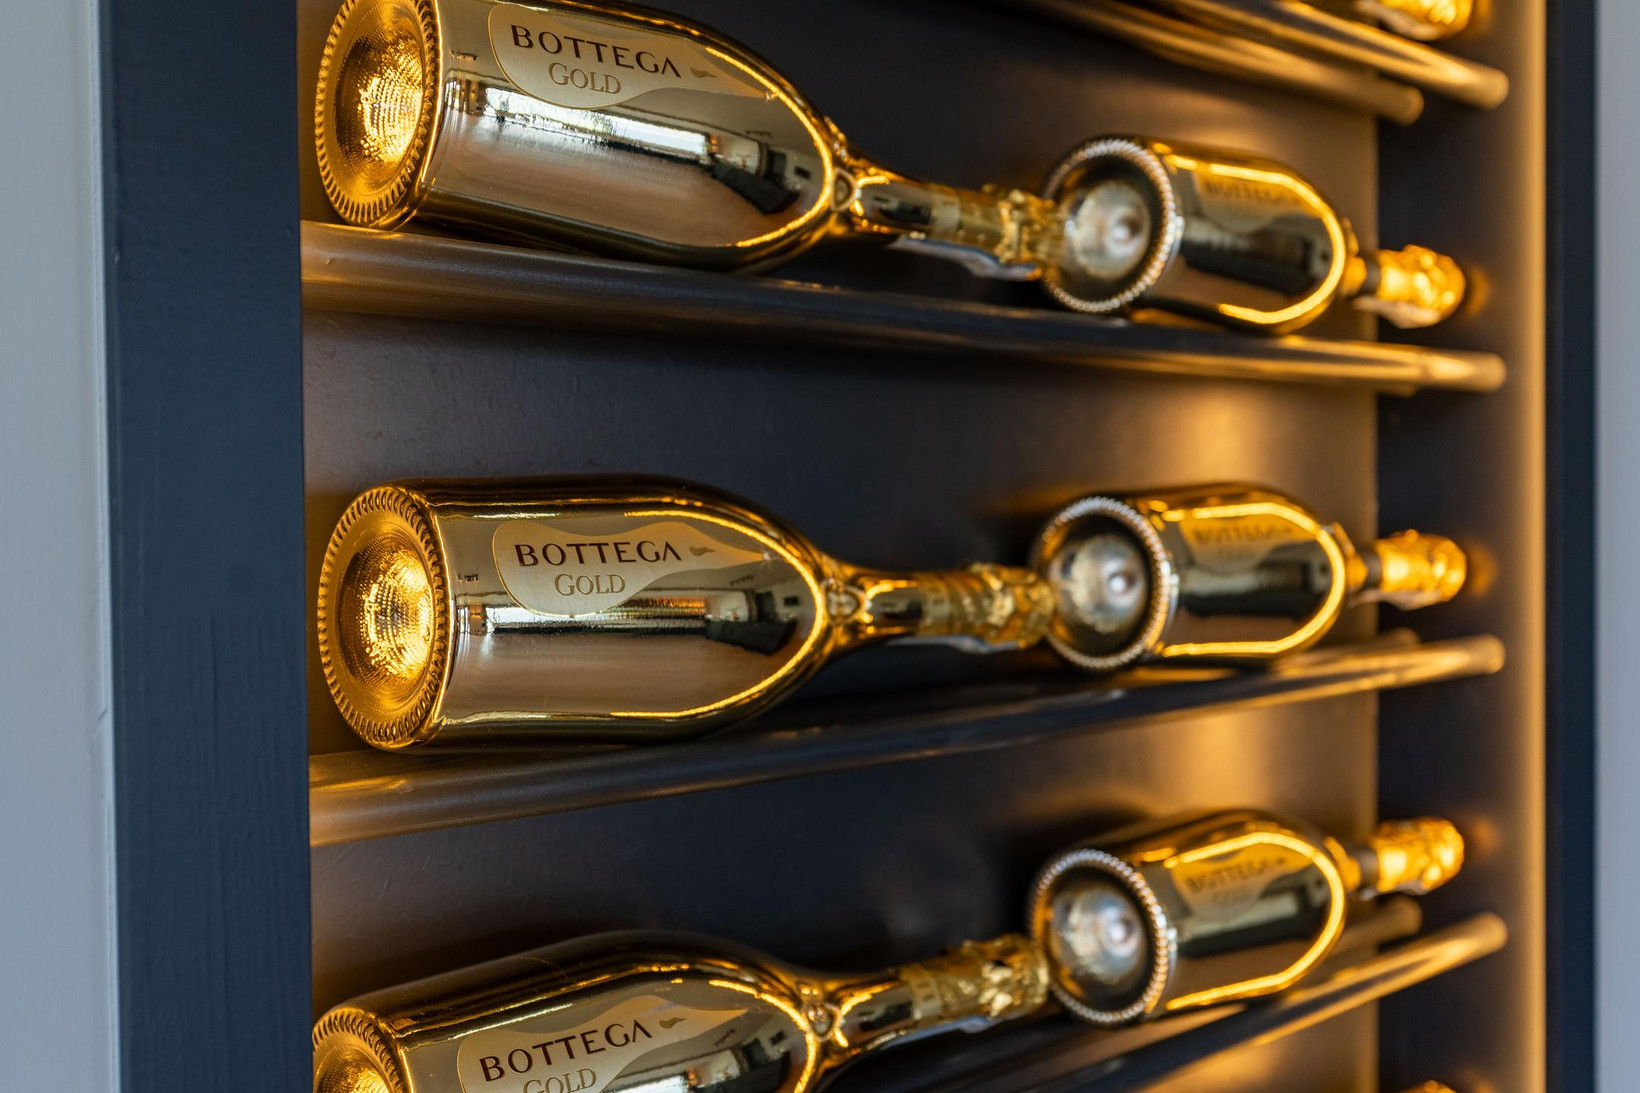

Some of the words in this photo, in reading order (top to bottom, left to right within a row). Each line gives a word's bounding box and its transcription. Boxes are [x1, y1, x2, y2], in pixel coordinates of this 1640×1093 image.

[510, 24, 682, 78] BOTTEGA
[549, 62, 621, 95] GOLD
[514, 540, 682, 567] BOTTEGA
[554, 573, 626, 597] GOLD
[479, 1019, 653, 1083] BOTTEGA
[522, 1067, 598, 1093] GOLD
